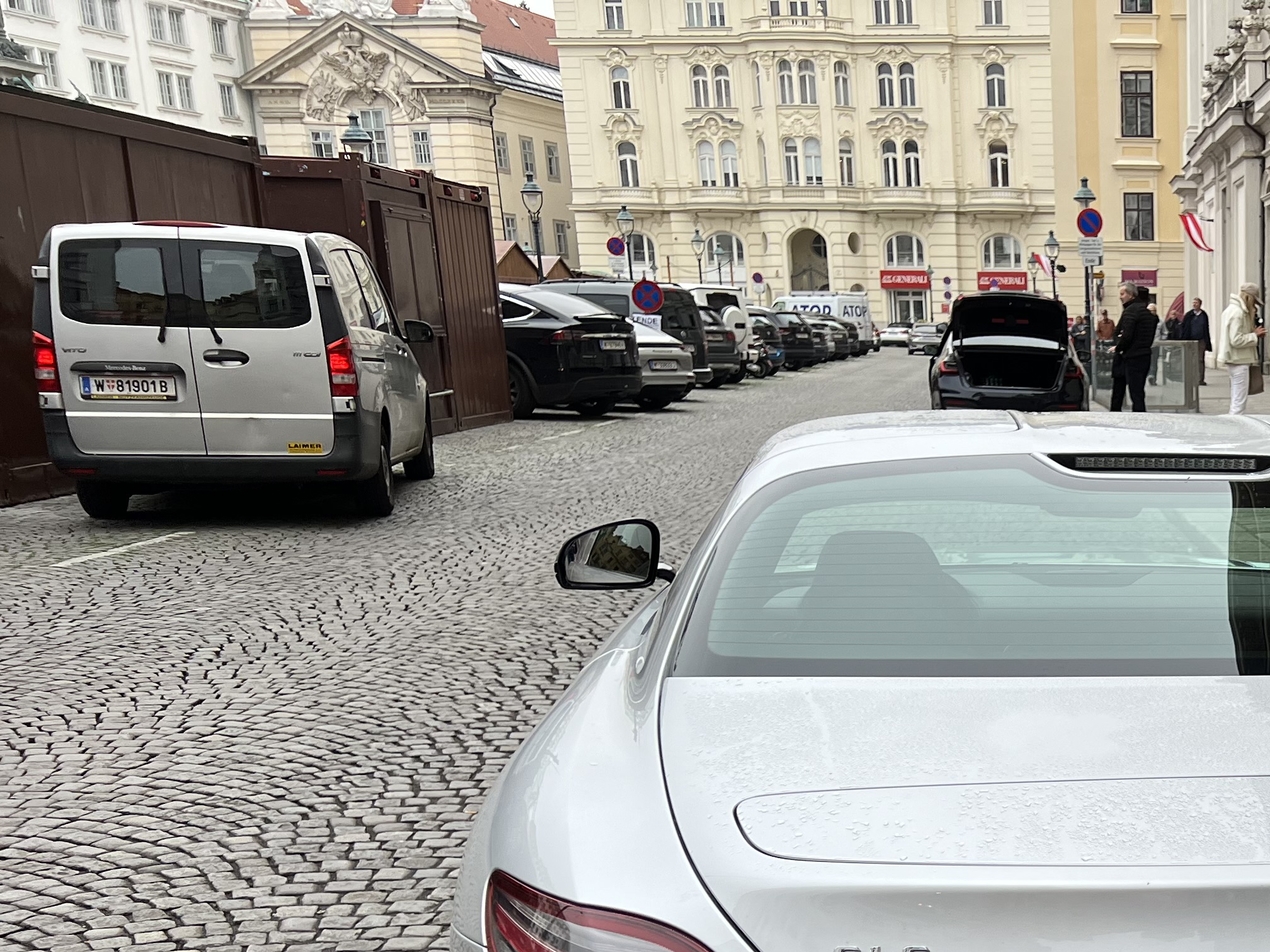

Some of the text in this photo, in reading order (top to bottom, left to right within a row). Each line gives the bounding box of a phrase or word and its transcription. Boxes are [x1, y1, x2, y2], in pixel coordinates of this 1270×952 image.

[891, 275, 928, 284] GENERALI
[842, 305, 868, 317] ATOP
[636, 316, 658, 325] ENDE
[94, 379, 105, 392] W
